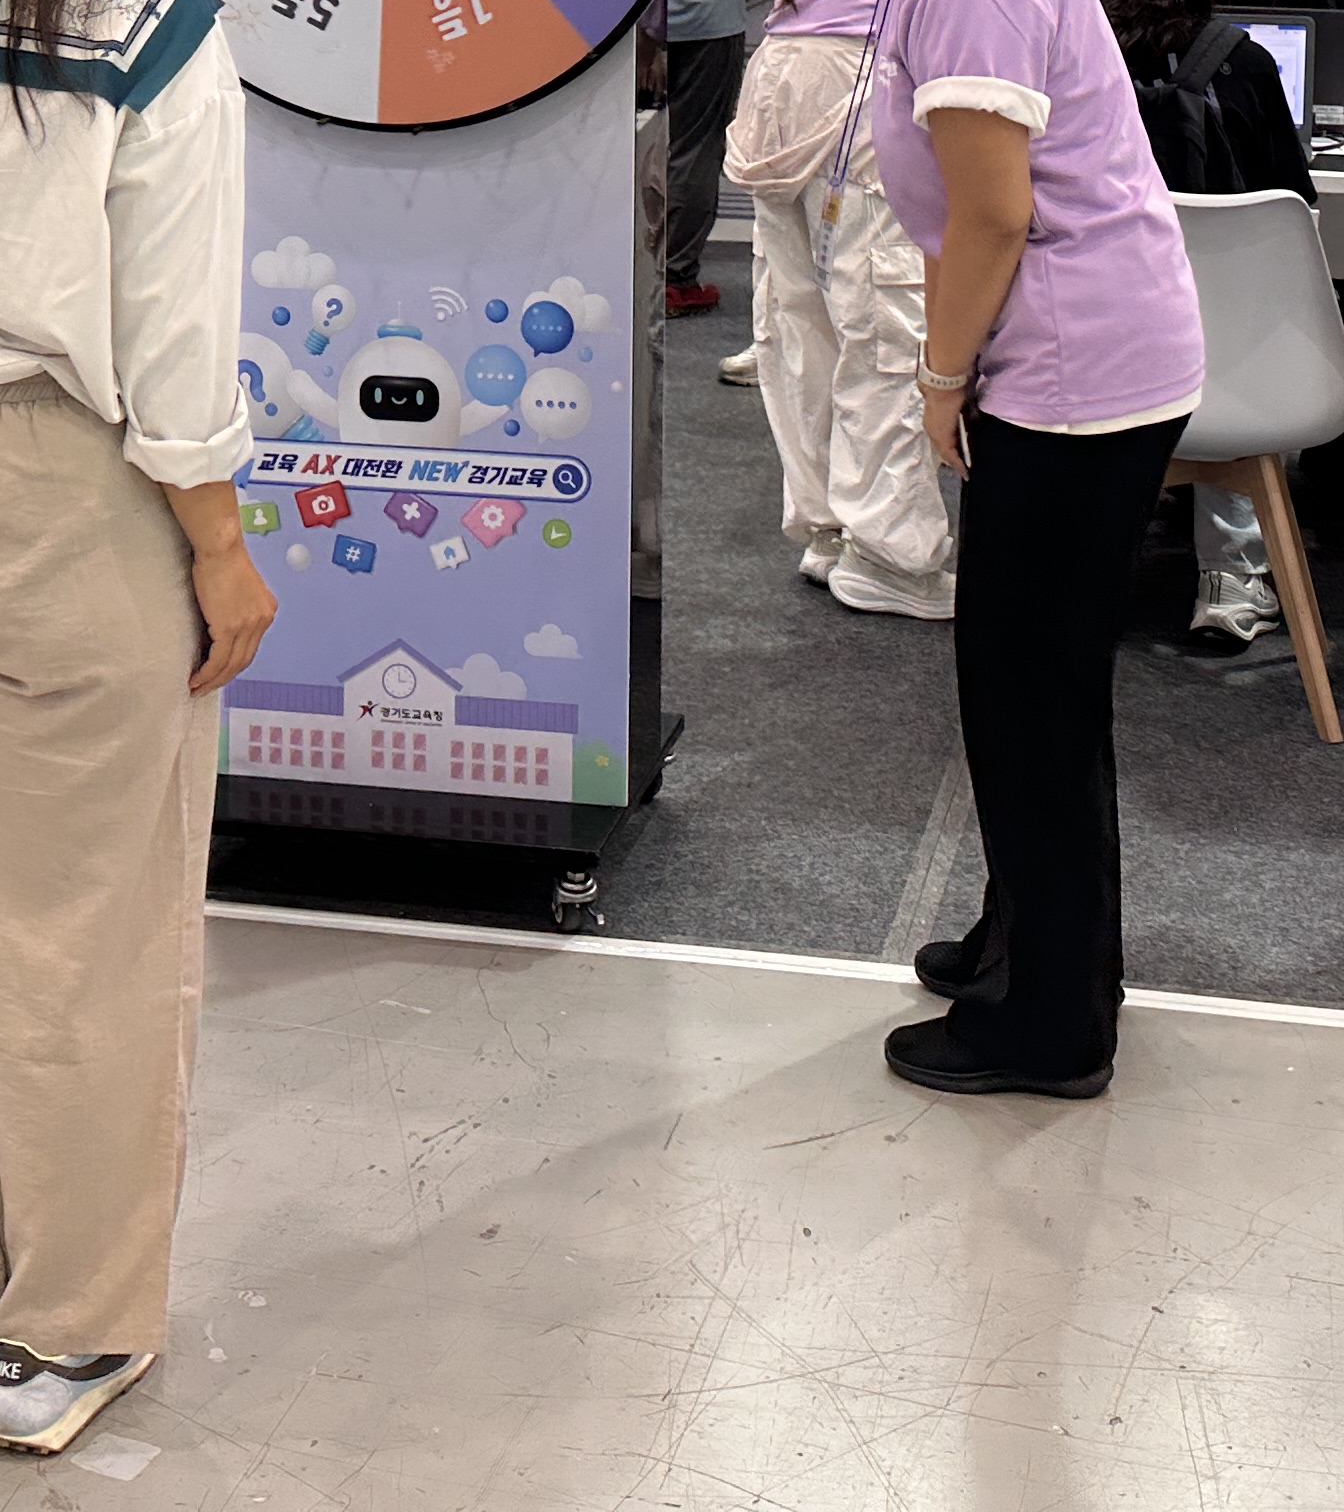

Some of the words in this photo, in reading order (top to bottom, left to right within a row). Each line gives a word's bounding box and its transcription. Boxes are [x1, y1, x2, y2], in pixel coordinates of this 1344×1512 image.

[257, 452, 299, 474] 교육
[301, 453, 343, 476] AX
[341, 457, 403, 480] 대전환
[409, 459, 470, 484] NEW
[467, 463, 548, 488] 경기교육
[380, 706, 443, 722] 경기도교육청
